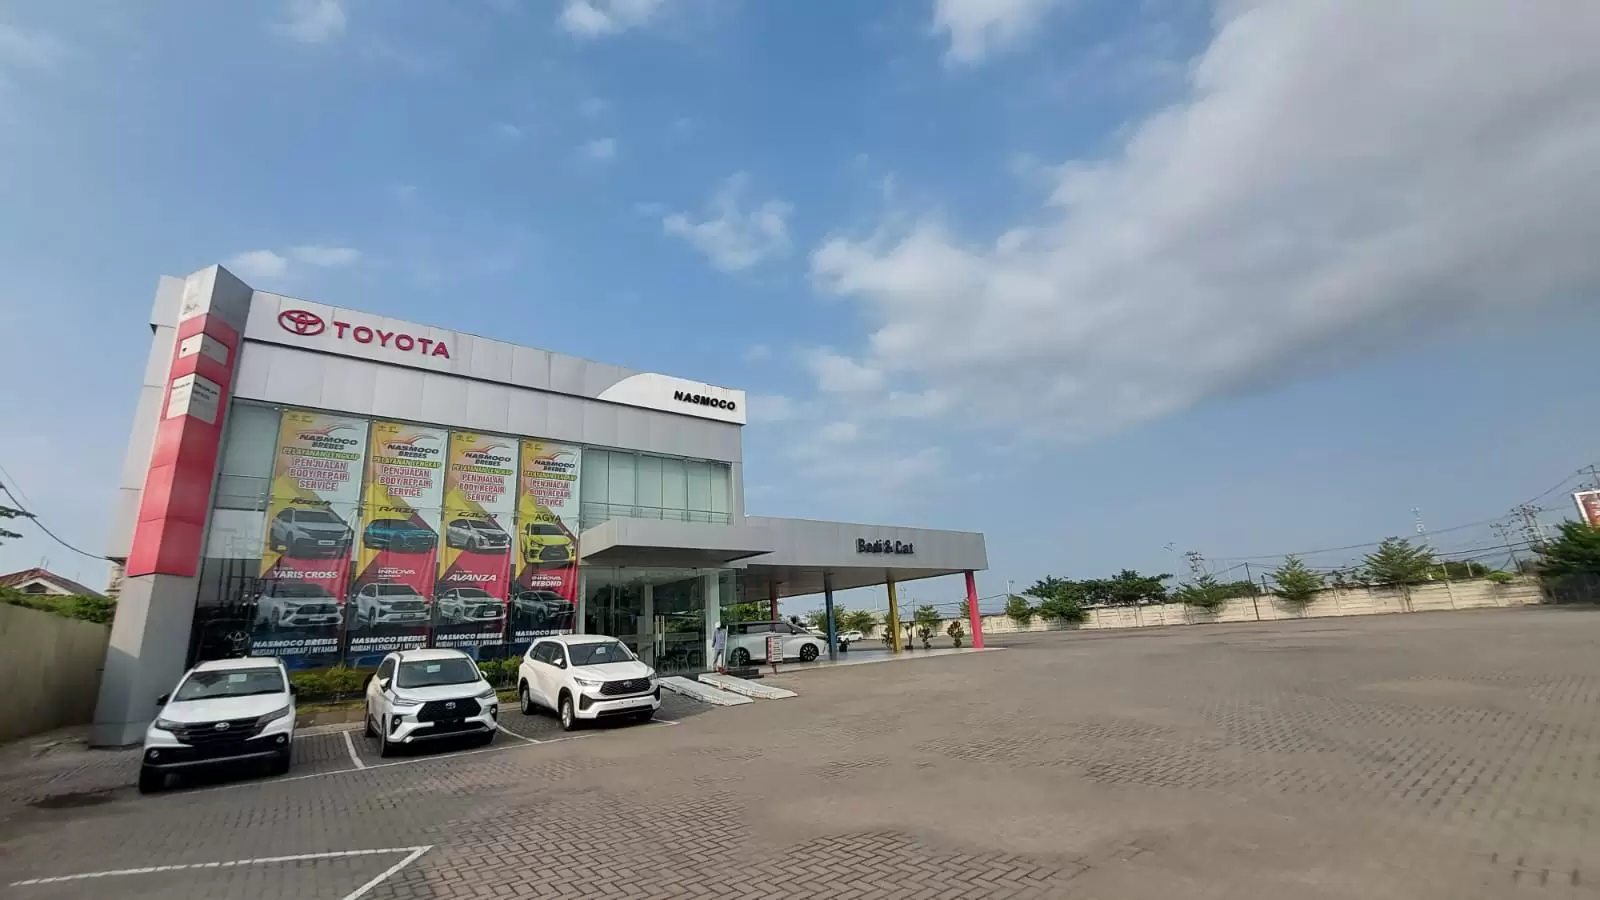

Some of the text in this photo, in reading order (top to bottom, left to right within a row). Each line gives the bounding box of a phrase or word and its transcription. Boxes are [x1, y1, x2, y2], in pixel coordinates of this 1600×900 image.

[333, 321, 450, 359] TOYOTA
[674, 390, 736, 410] NASMOCO
[299, 434, 358, 445] NASMOCO
[312, 442, 344, 450] BREBES
[387, 444, 439, 454] NASMOCO
[398, 451, 427, 459] BREBES
[465, 452, 511, 462] NASMOCO
[294, 458, 347, 470] PENJUALAN
[475, 459, 501, 467] BREBES
[534, 459, 575, 469] NASMOCO
[383, 466, 430, 477] PENJUALAN
[462, 474, 503, 484] PENJUALAN
[299, 480, 337, 490] SERVICE
[532, 480, 569, 489] PENJUALAN
[388, 487, 421, 497] SERVICE
[467, 493, 496, 502] SERVICE
[537, 498, 563, 507] SERVICE
[535, 513, 561, 522] AGYA
[895, 540, 914, 554] Cat
[272, 571, 338, 579] YARIS CROSS
[351, 636, 397, 644] NASMOCO
[436, 633, 476, 641] NASMOCO
[252, 638, 338, 648] NASMOCO BREBES
